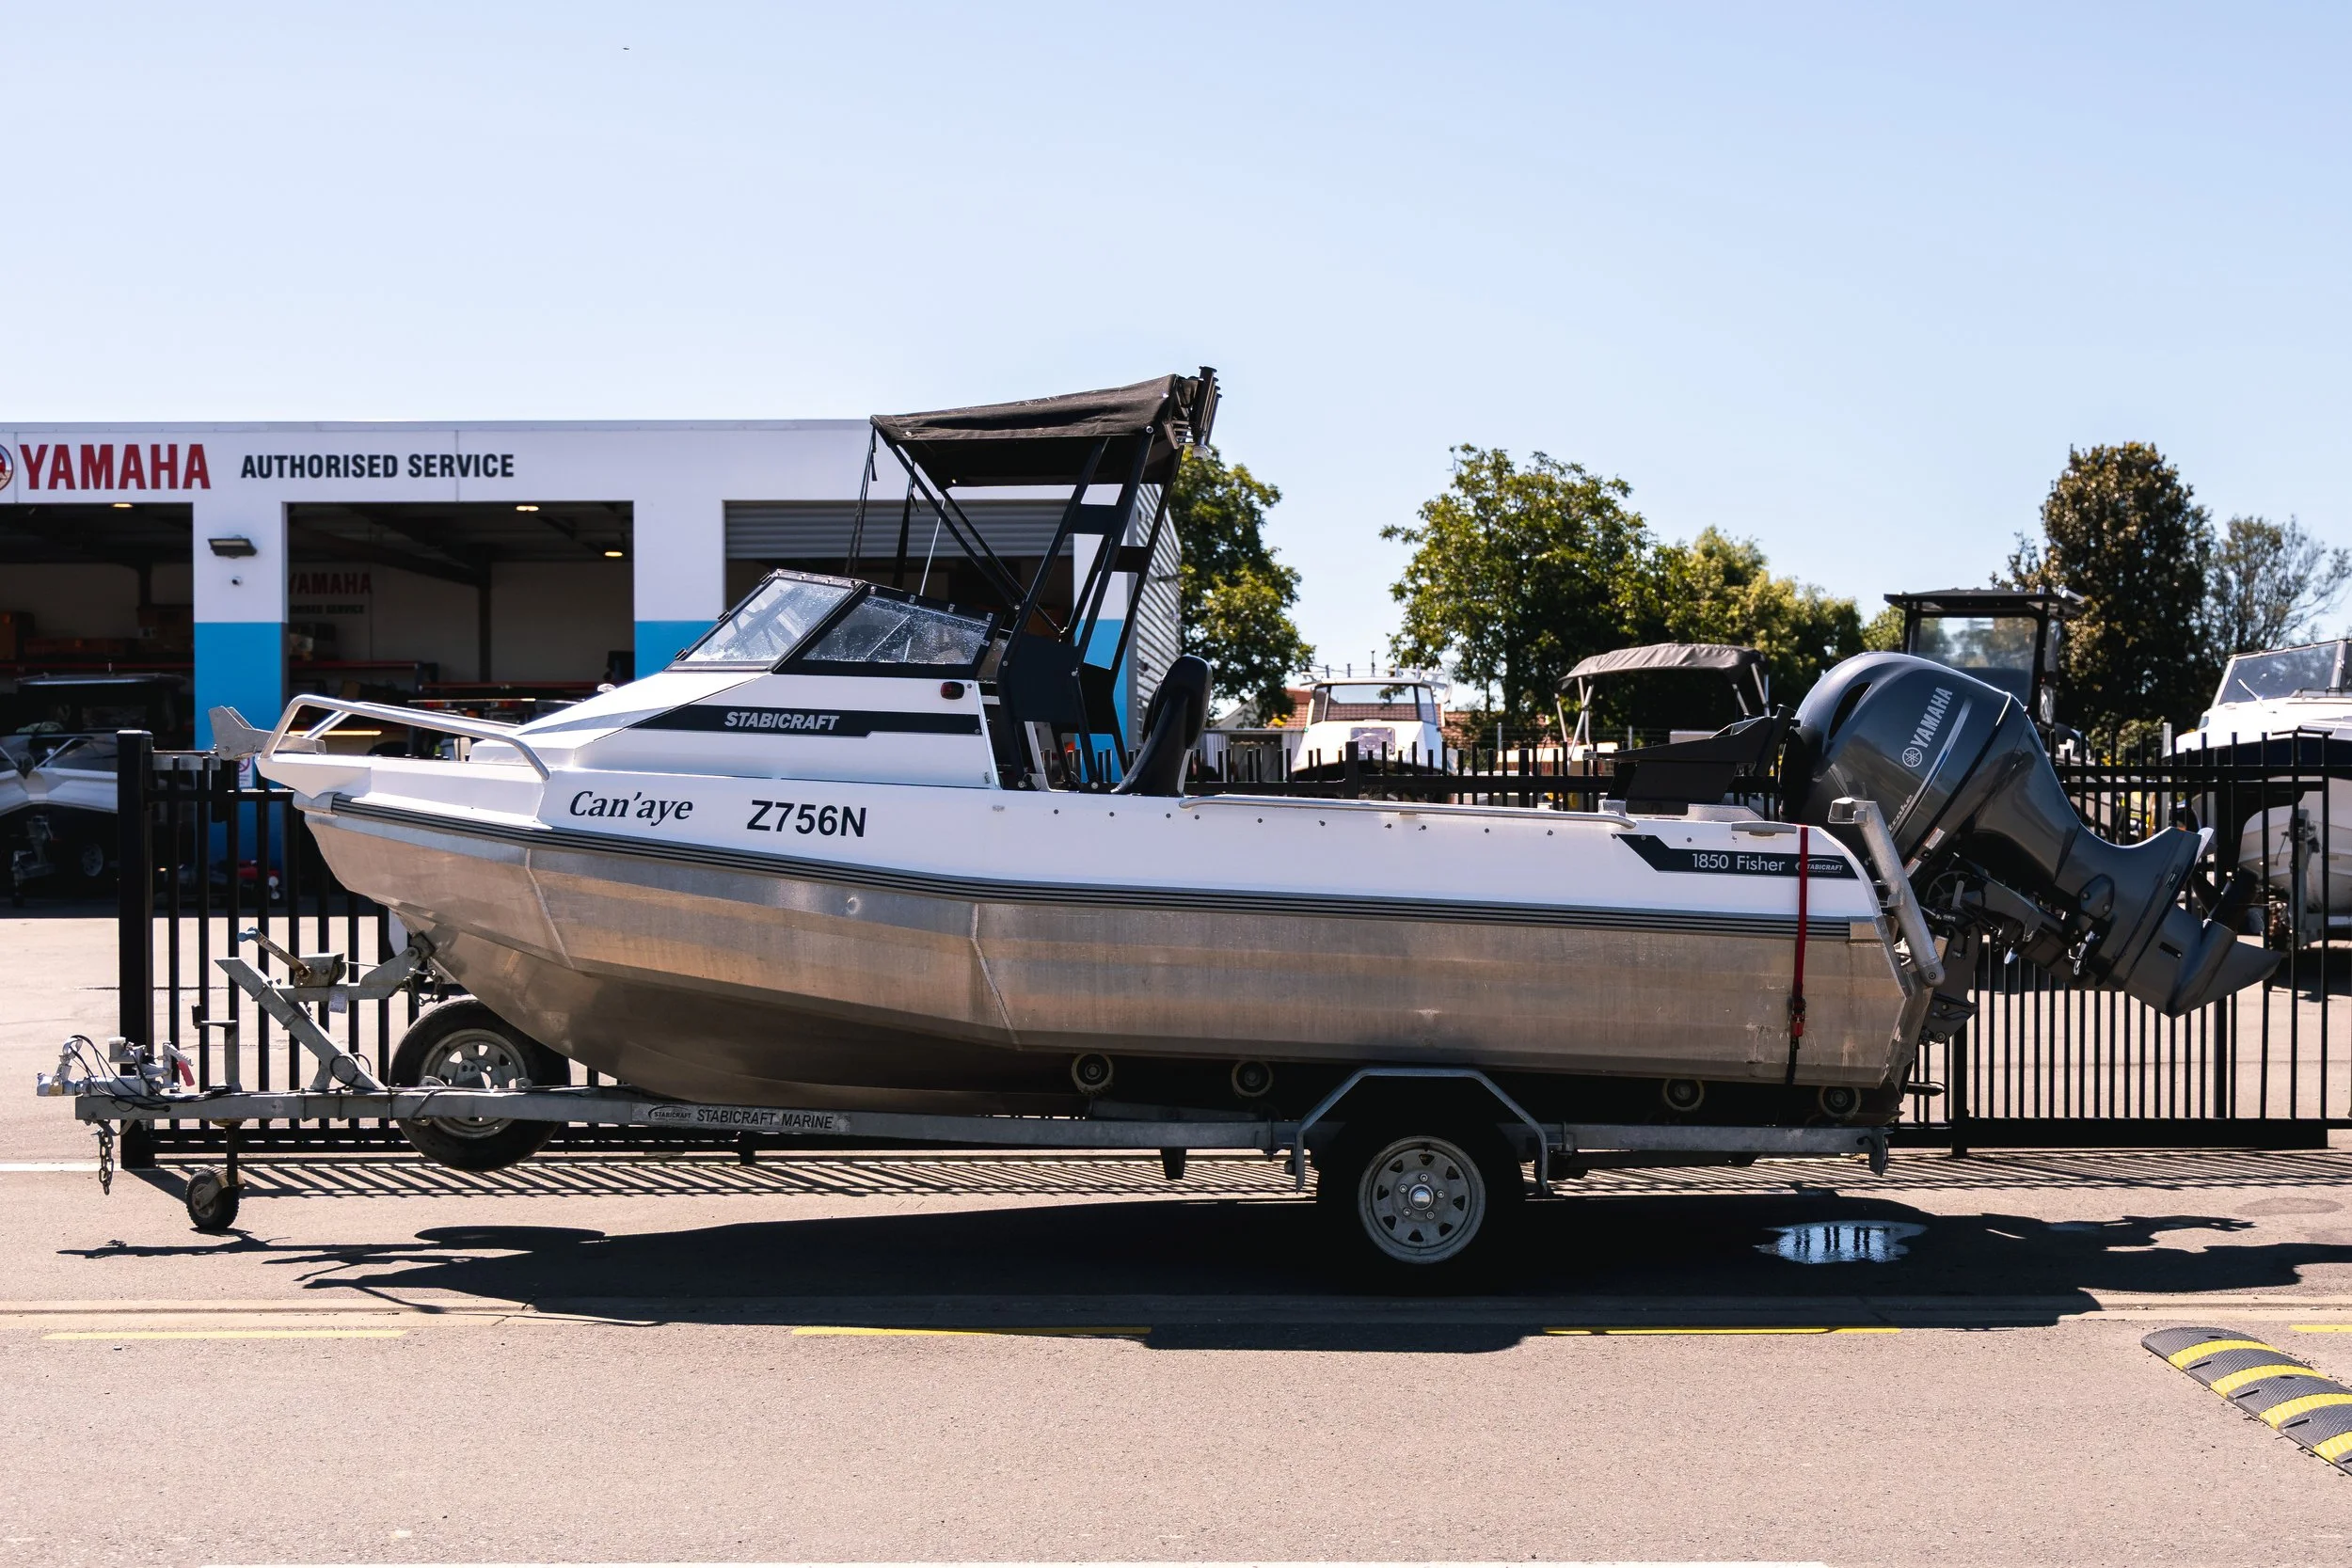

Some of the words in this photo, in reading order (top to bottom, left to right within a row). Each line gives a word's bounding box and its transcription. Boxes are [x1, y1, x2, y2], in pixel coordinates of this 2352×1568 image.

[19, 444, 212, 490] YAMAHA
[241, 454, 399, 479] AUTHORISED
[407, 453, 515, 478] SERVICE
[724, 711, 840, 731] STABICRAFT
[1910, 687, 1953, 748] YAMAHA
[569, 790, 693, 826] Can'aye
[746, 799, 866, 837] Z756N
[1692, 853, 1729, 869] 1850
[1737, 855, 1786, 872] Fisher
[654, 1111, 691, 1119] STABICRAFT
[696, 1109, 776, 1125] STABICRAFT
[781, 1113, 834, 1129] MARINE
